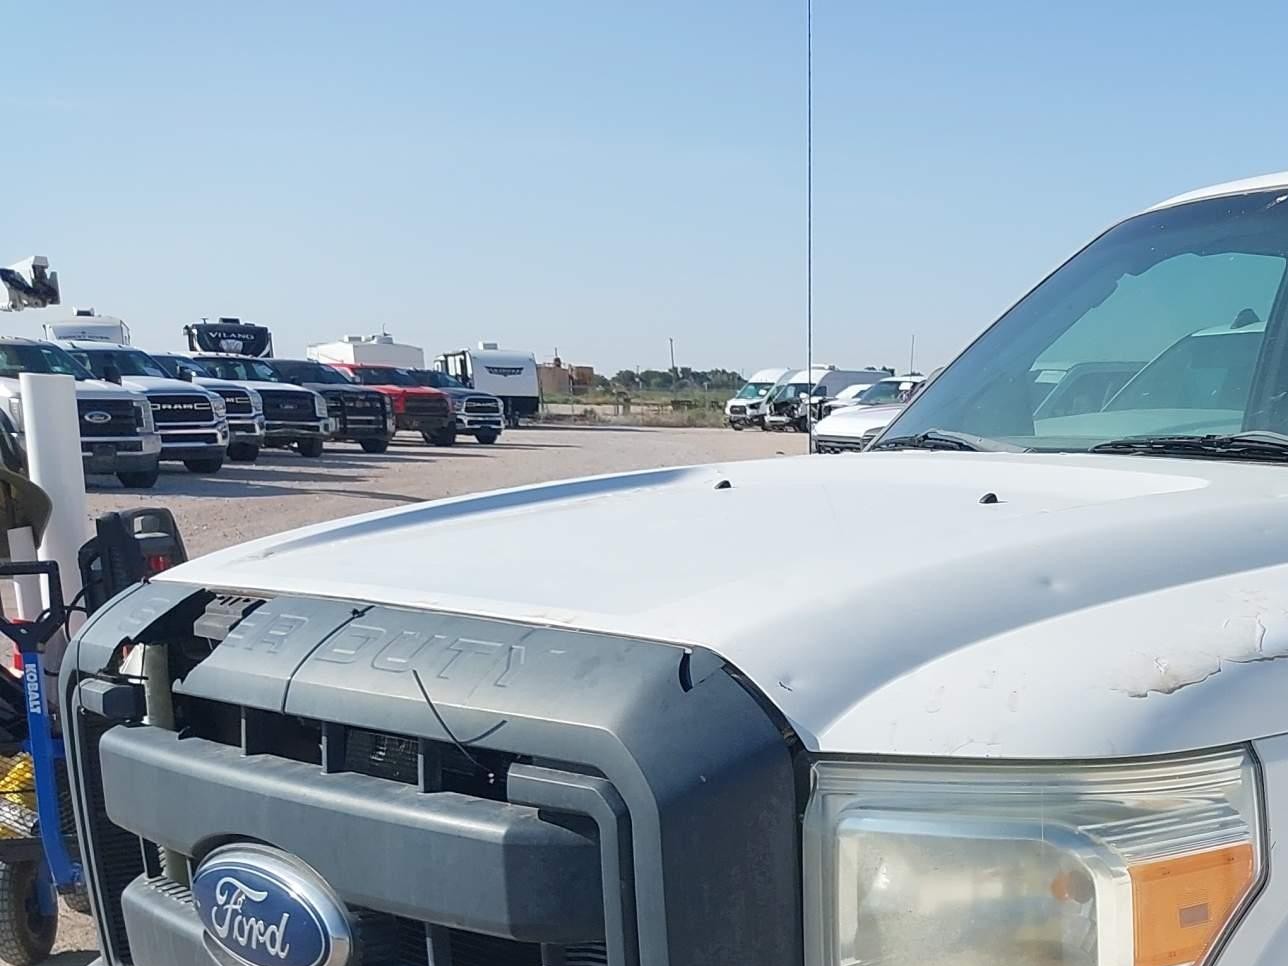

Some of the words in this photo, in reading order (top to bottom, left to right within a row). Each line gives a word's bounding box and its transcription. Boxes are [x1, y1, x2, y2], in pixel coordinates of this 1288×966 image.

[208, 331, 255, 340] VILANO
[24, 663, 42, 715] KOBALT
[211, 876, 291, 960] Ford
